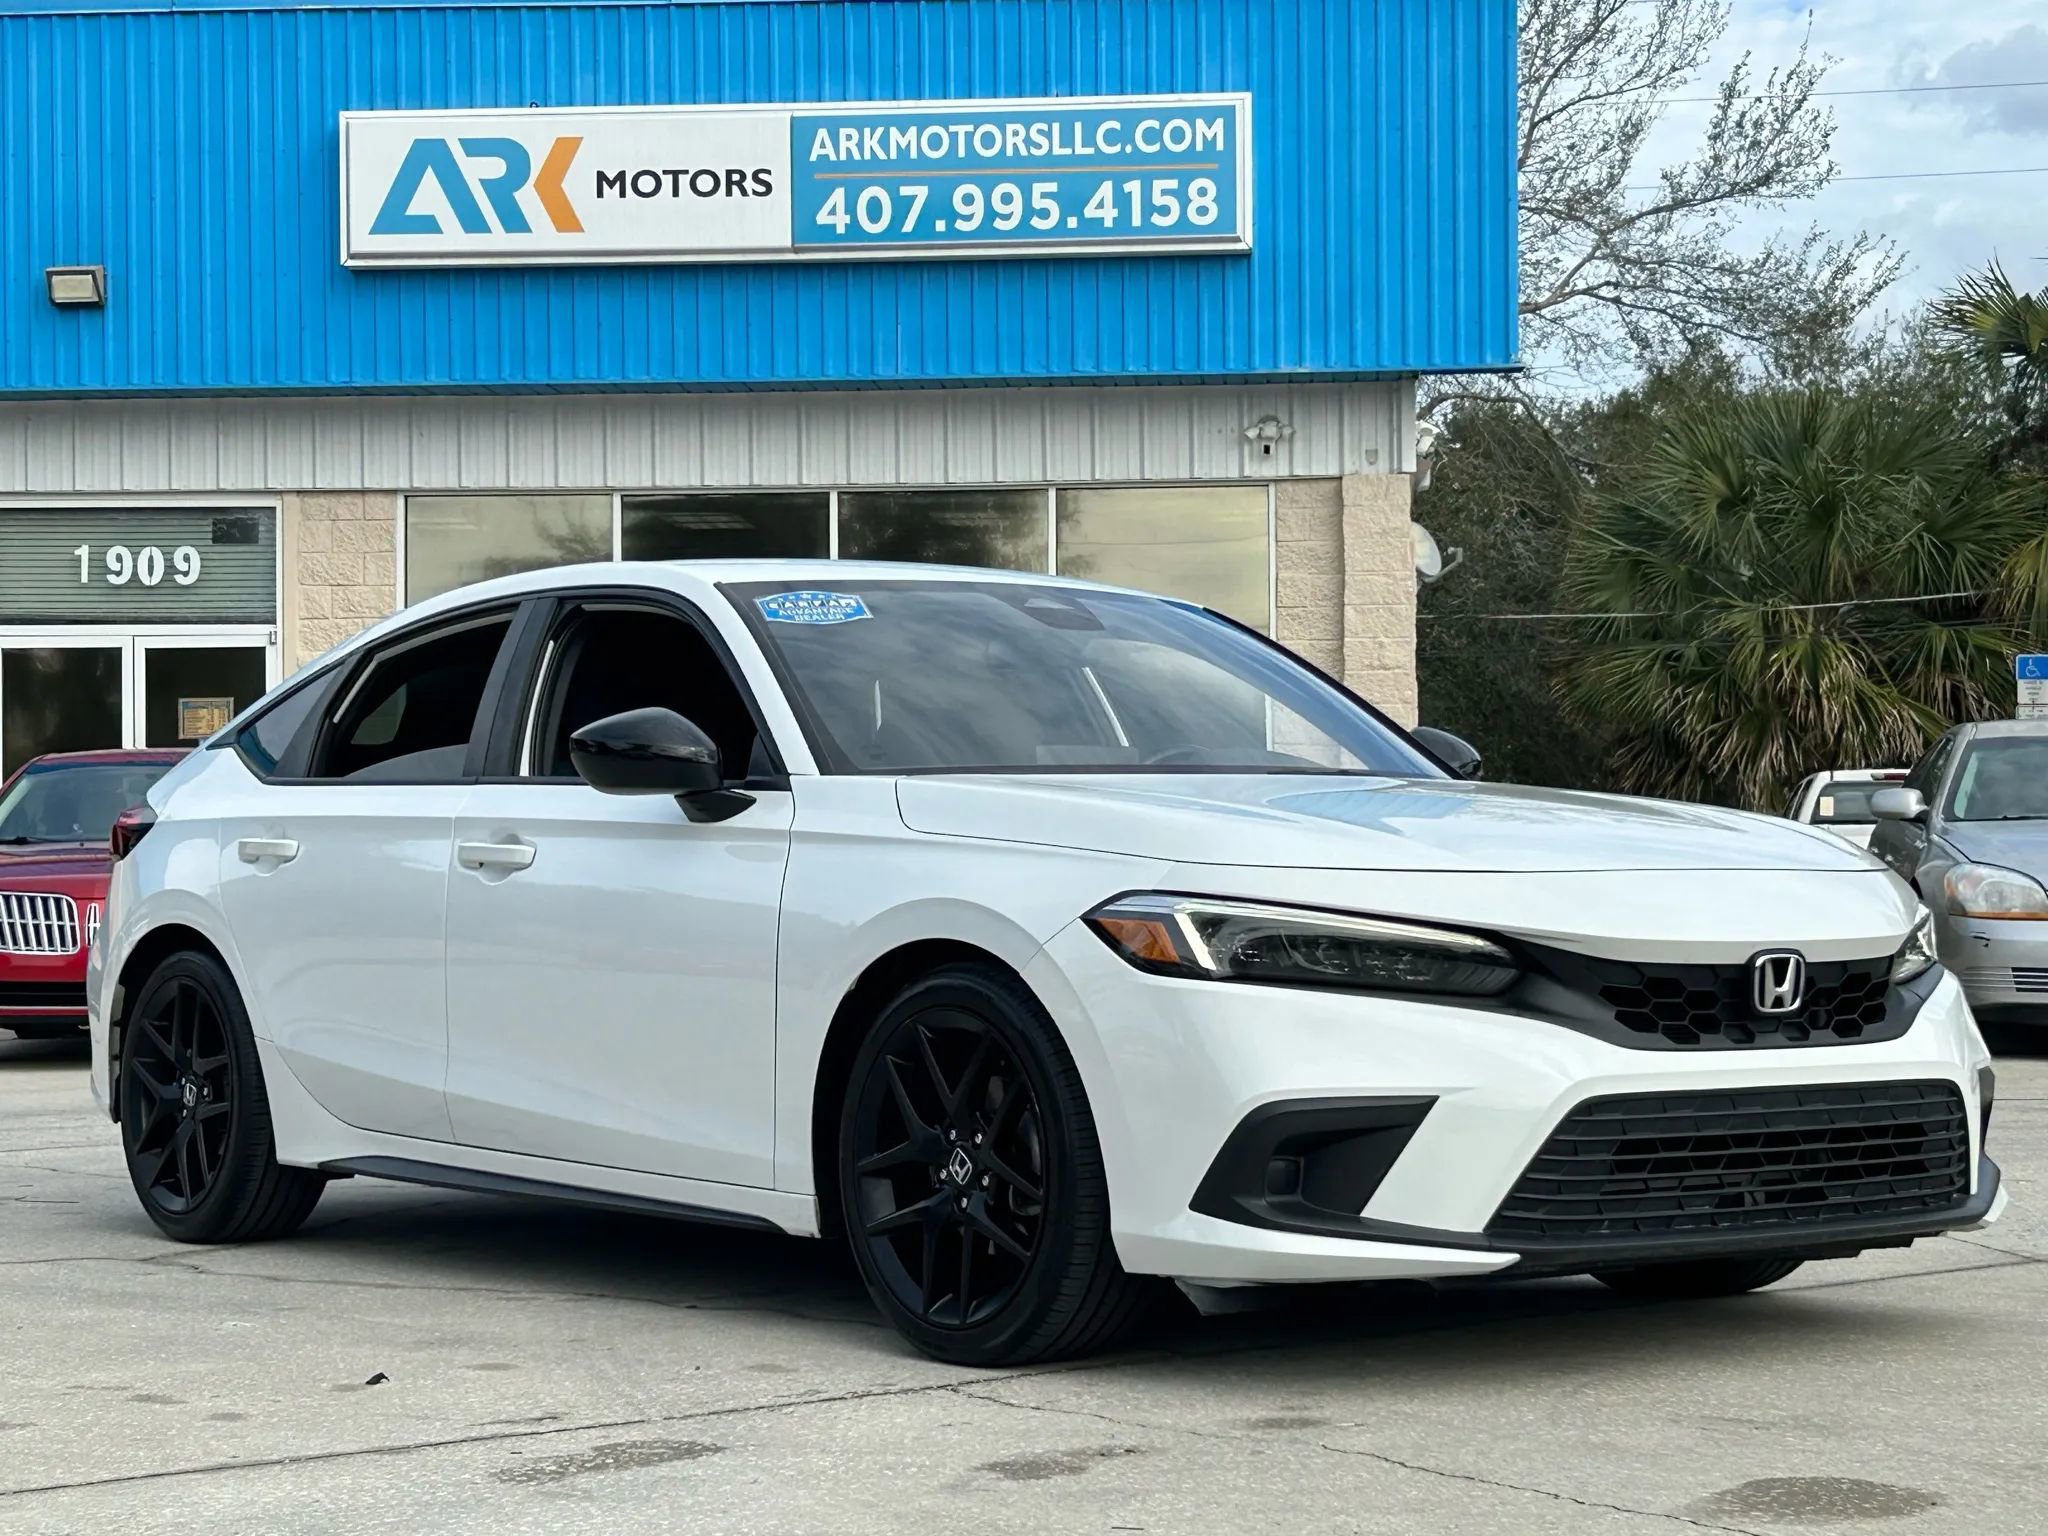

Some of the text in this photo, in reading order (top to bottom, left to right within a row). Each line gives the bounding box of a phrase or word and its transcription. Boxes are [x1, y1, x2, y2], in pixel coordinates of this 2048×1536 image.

[808, 117, 1225, 162] ARKMOTORSLLC.COM
[368, 137, 774, 235] ARK MOTORS
[815, 177, 1219, 234] 407.995.4158
[73, 544, 202, 586] 1909
